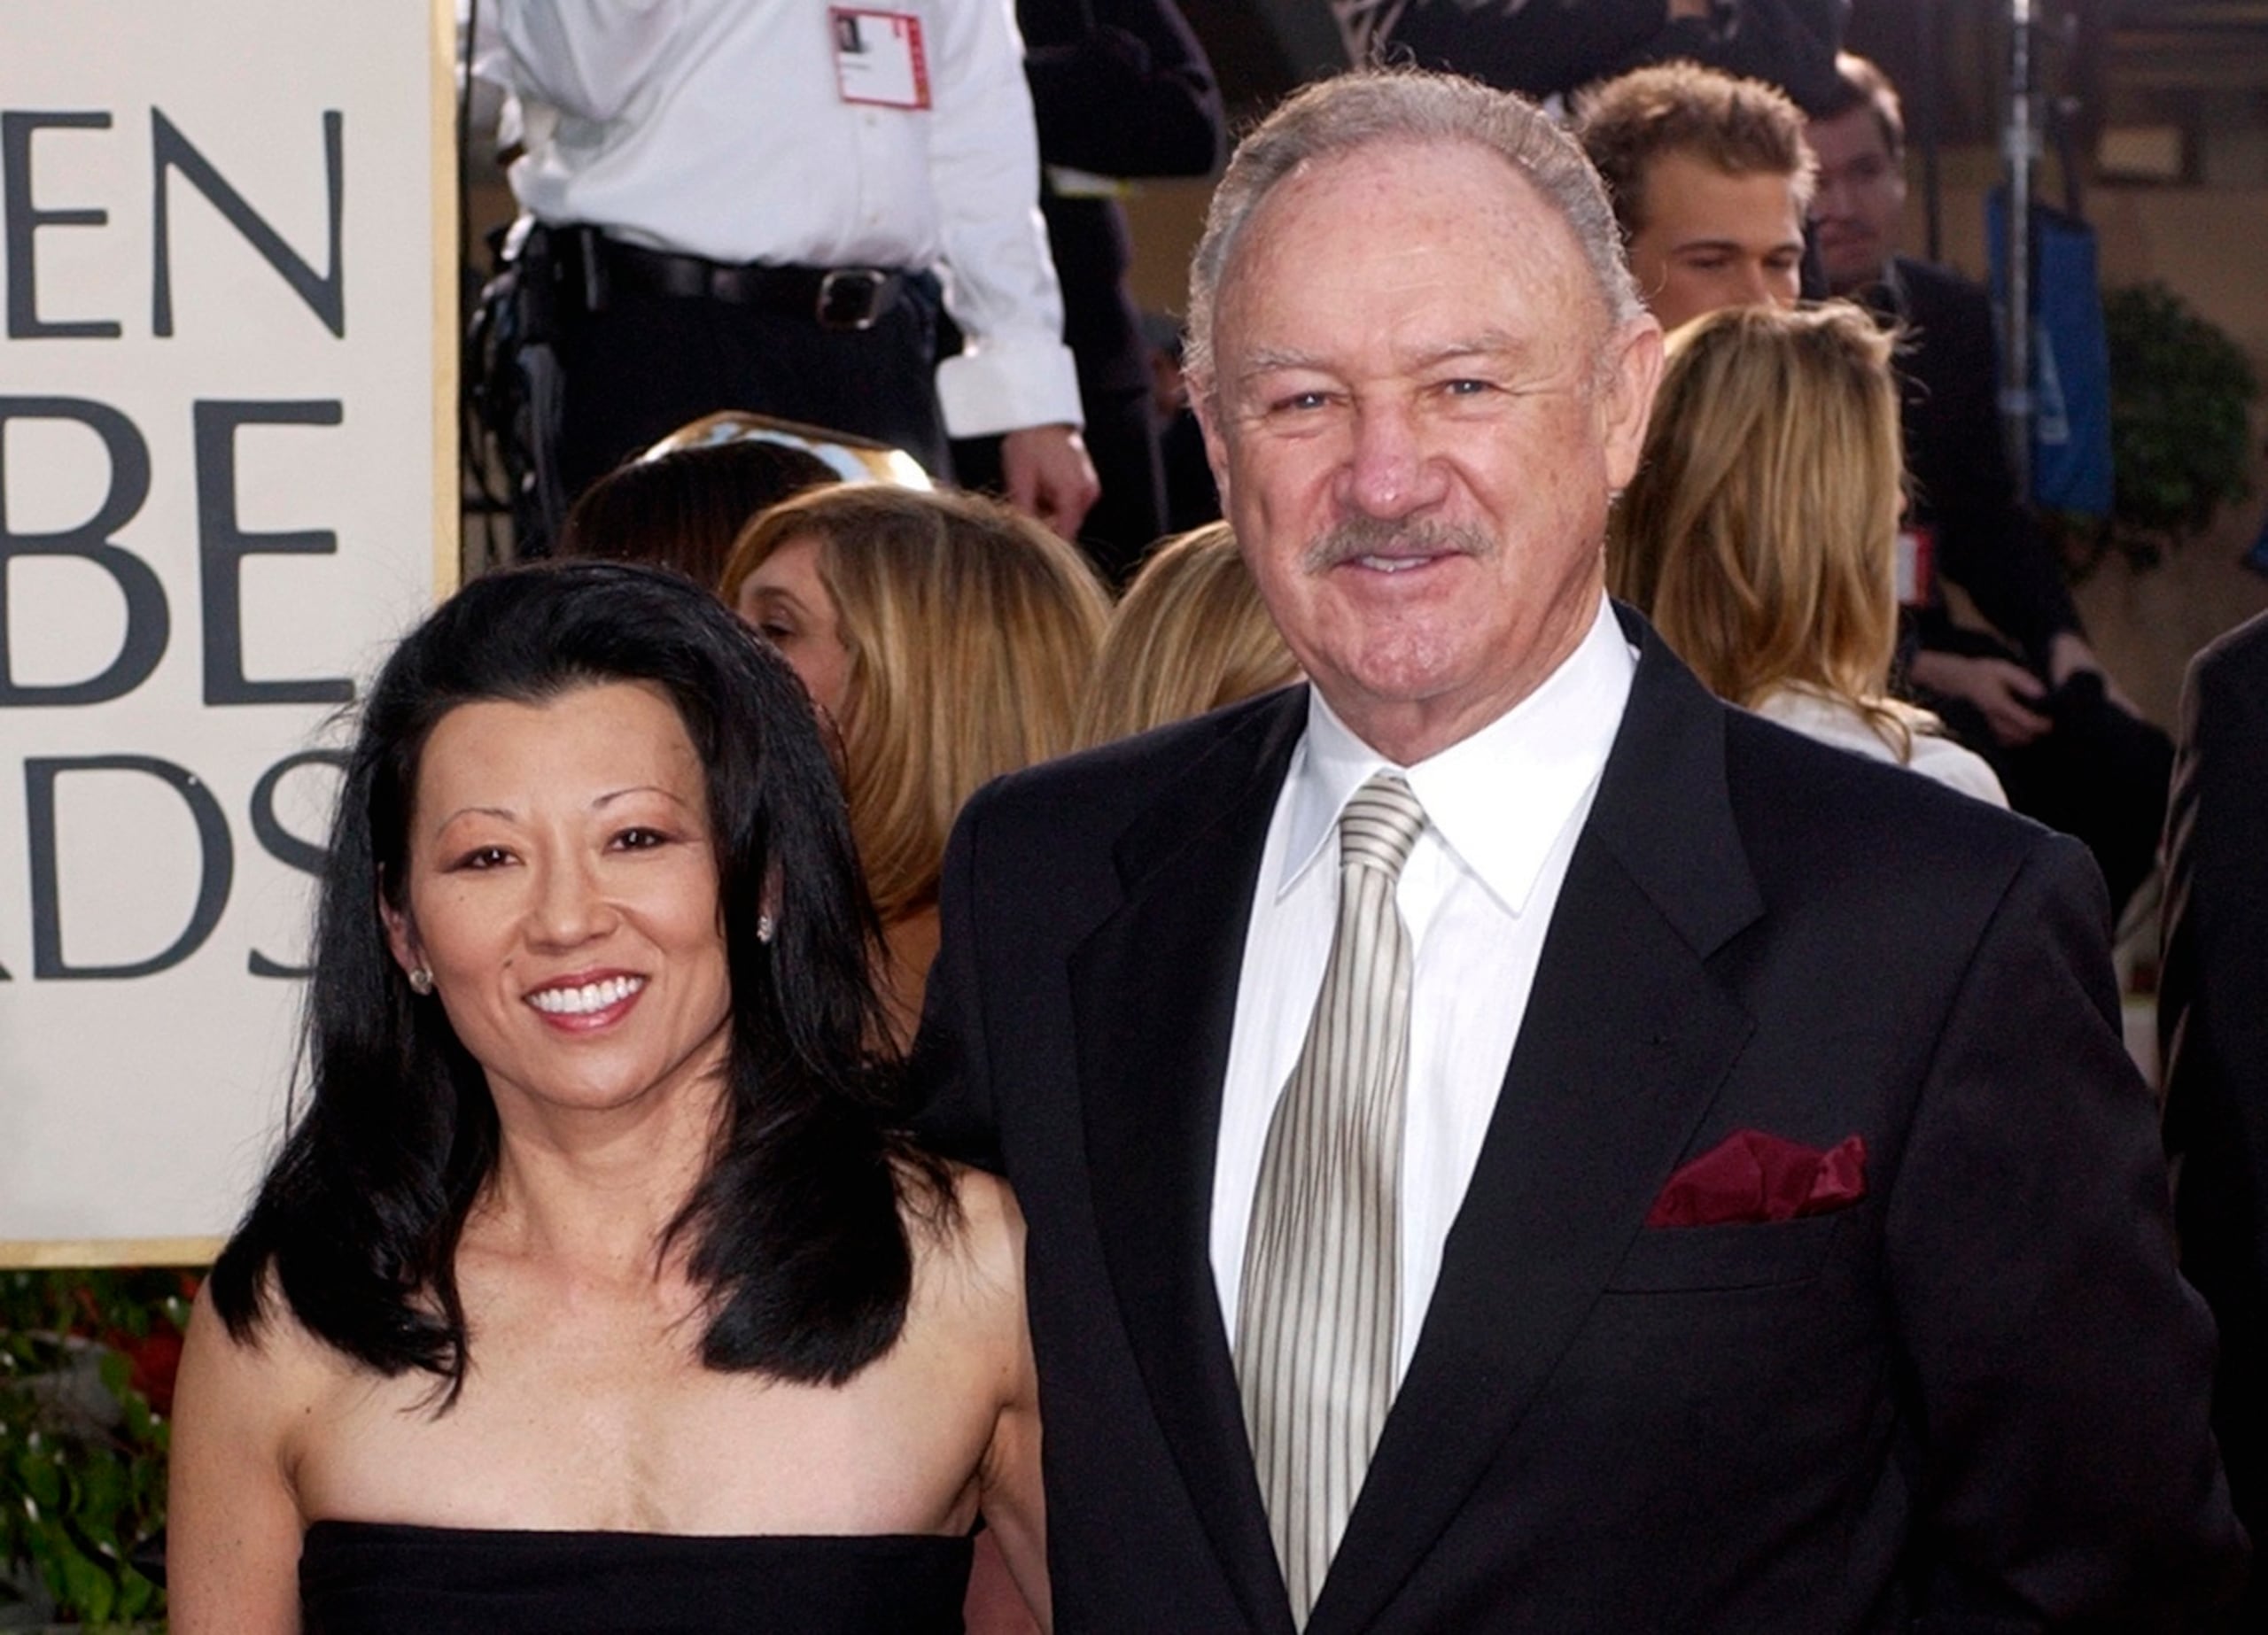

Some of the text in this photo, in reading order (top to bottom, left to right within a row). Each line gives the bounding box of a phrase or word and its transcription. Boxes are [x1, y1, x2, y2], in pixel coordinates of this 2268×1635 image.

[0, 106, 344, 339] EN
[0, 396, 355, 707] BE
[0, 748, 354, 981] DS
